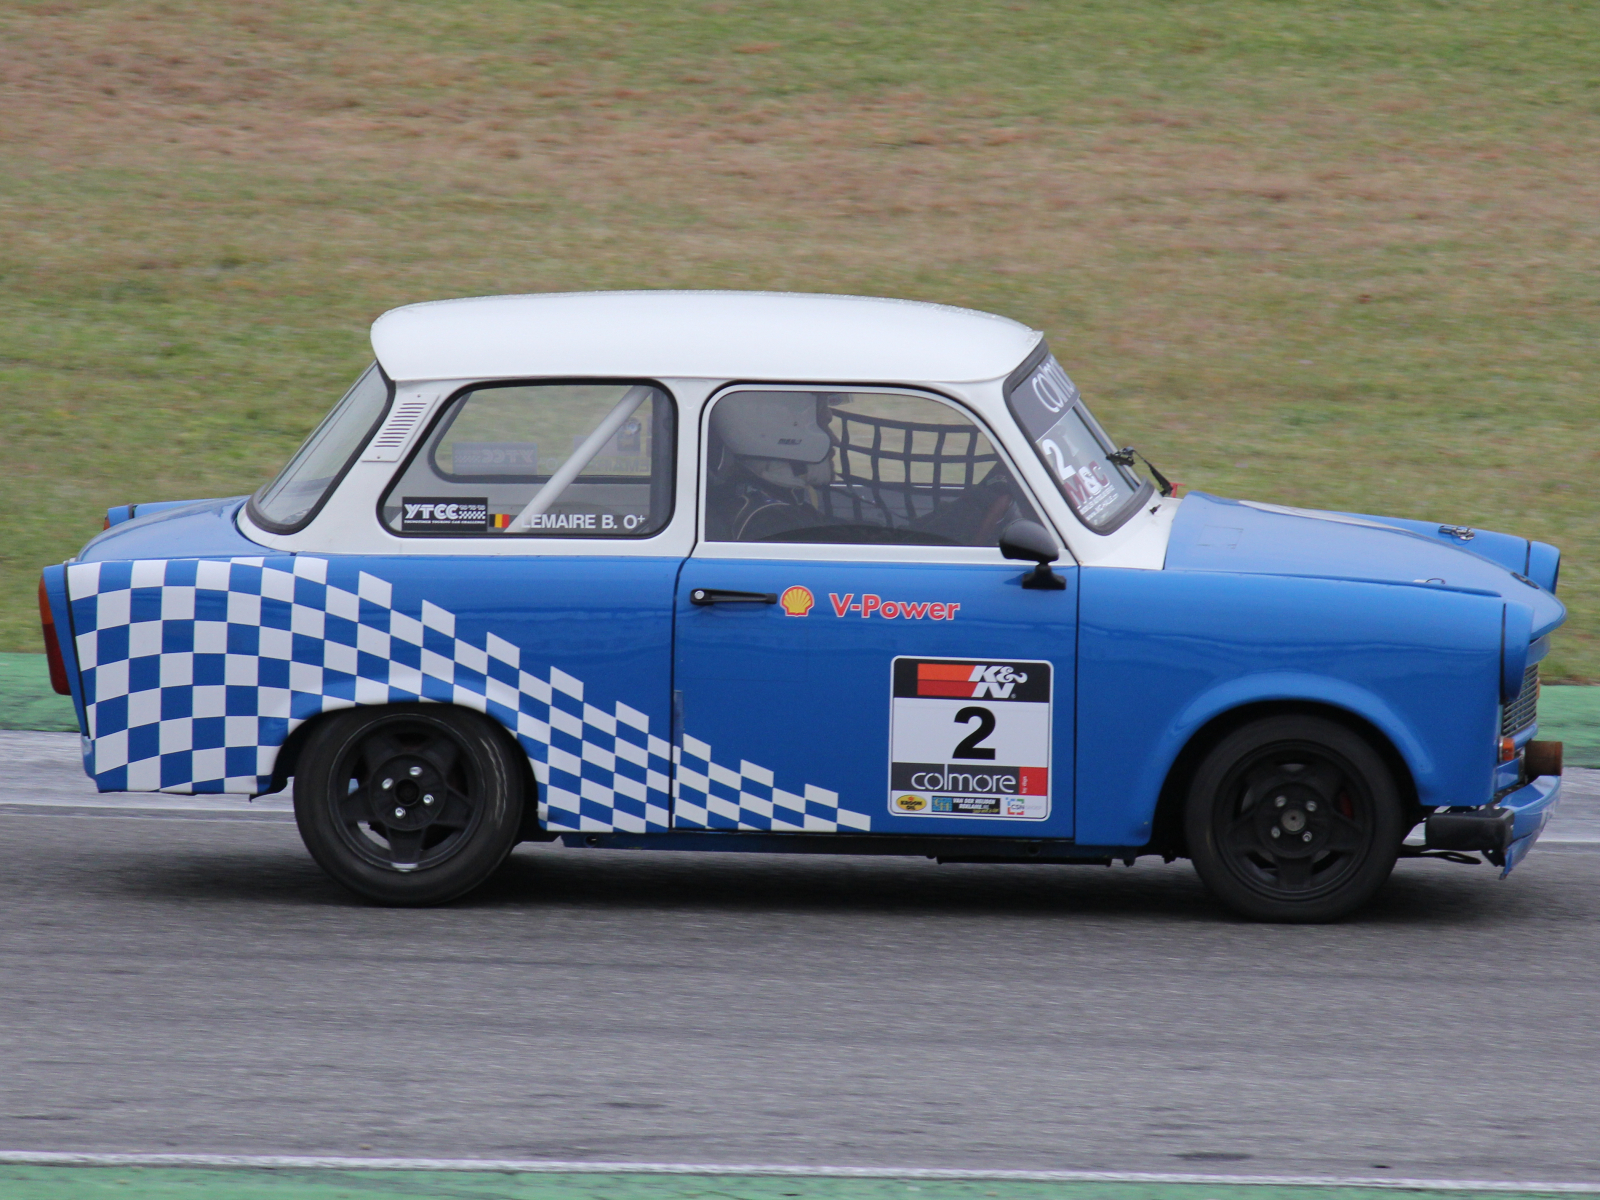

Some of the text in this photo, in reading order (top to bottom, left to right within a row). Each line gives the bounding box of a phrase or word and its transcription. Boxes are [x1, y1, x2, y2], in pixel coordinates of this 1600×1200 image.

[1042, 438, 1076, 480] 2
[1064, 460, 1110, 508] M&C
[404, 503, 459, 520] YTCC
[521, 513, 596, 529] LEMAIRE
[601, 514, 618, 529] B.
[828, 593, 961, 621] V-Power
[952, 706, 996, 760] 2
[911, 764, 1016, 793] colmore
